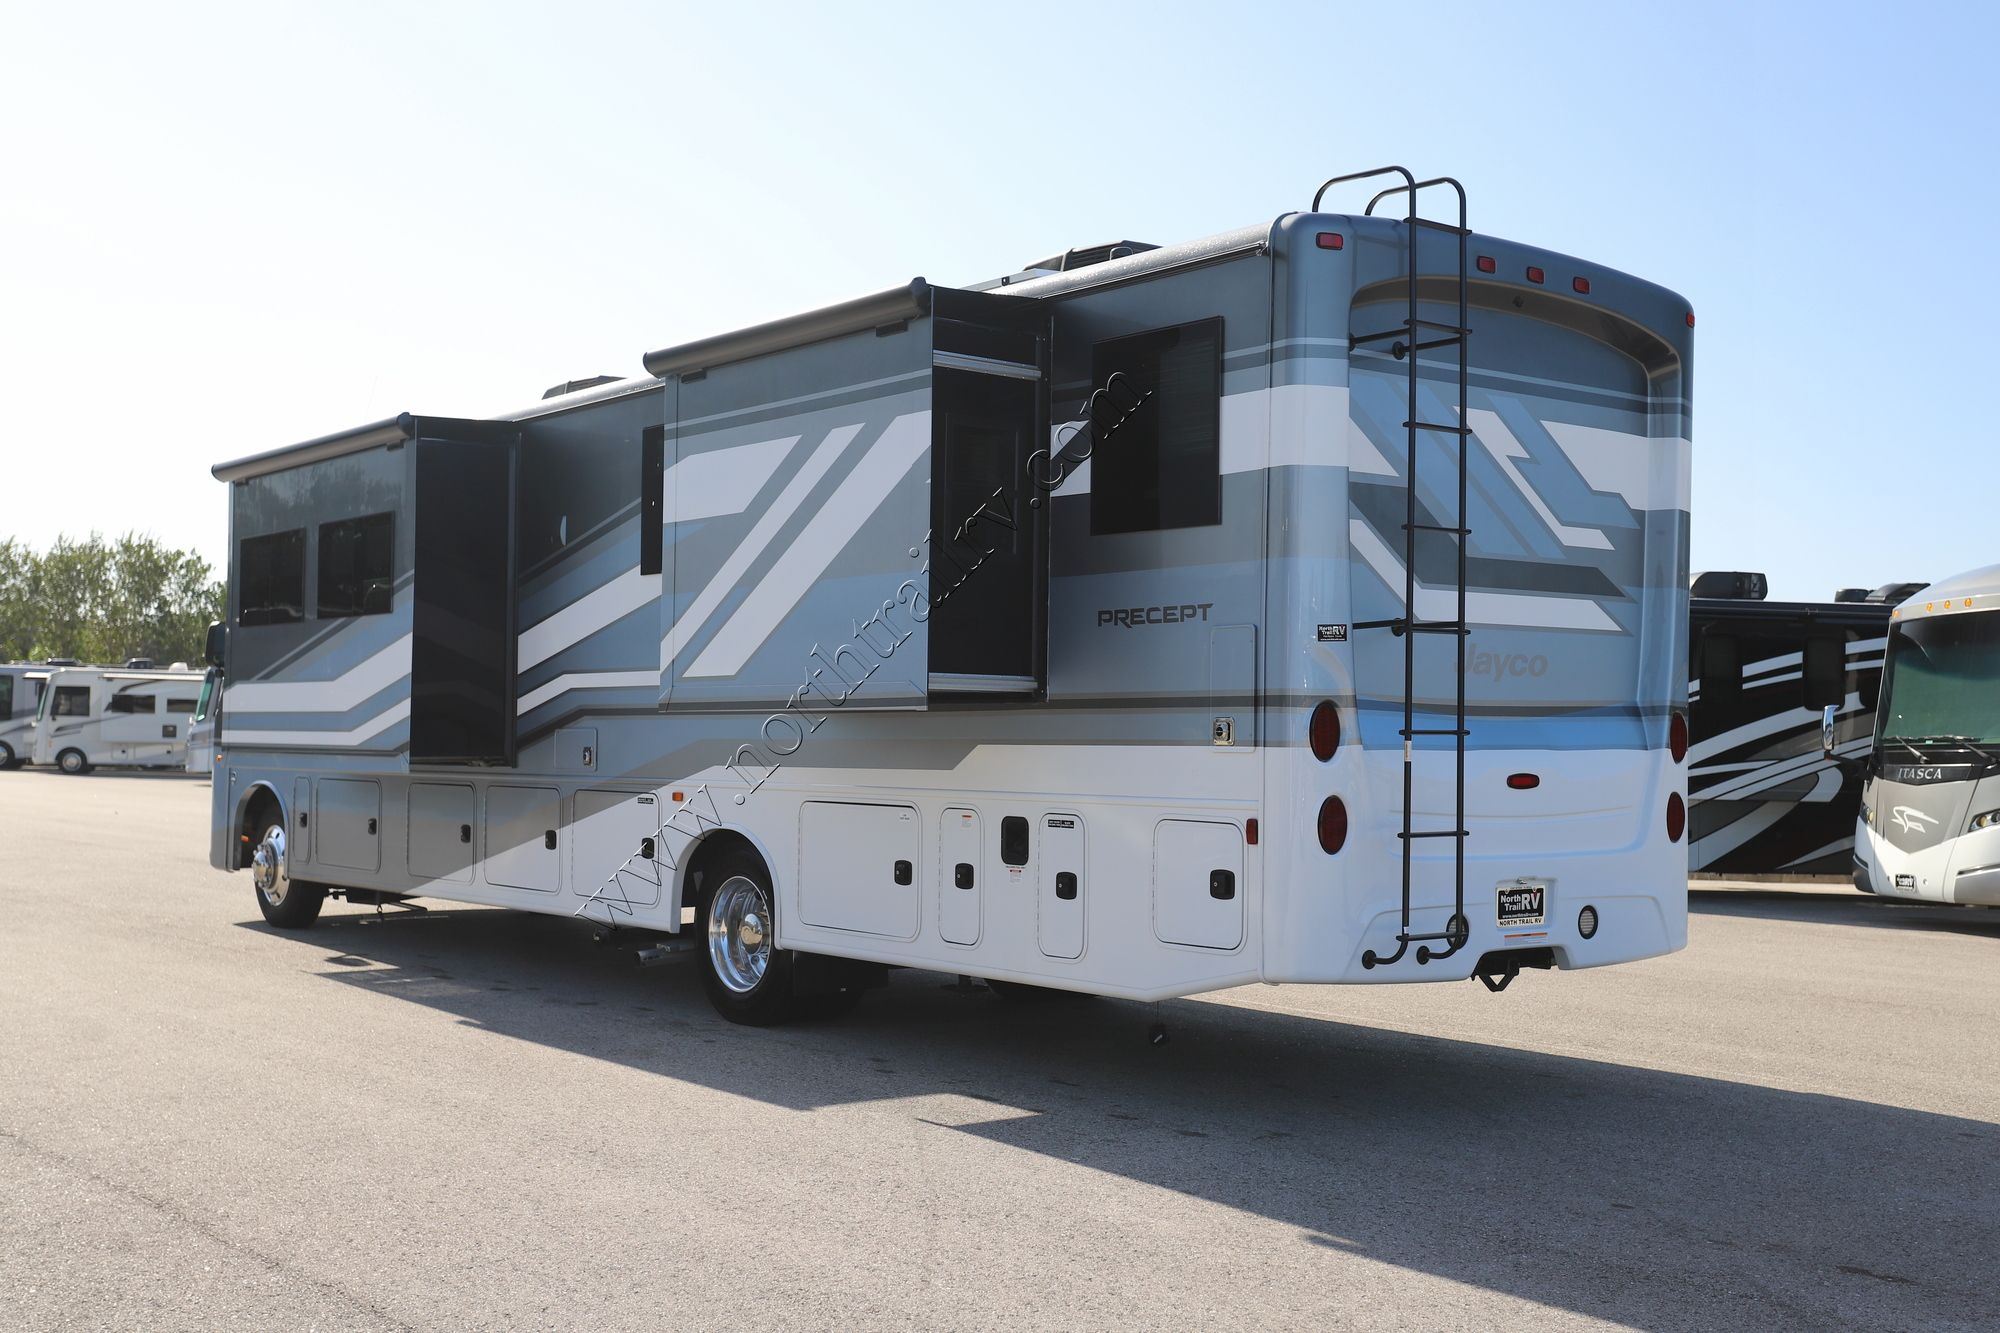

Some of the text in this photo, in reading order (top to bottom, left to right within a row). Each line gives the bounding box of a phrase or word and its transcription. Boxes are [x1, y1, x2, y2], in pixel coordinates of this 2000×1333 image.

[1098, 603, 1214, 629] PRECEPT
[1333, 626, 1345, 635] RV
[1454, 643, 1549, 682] Jayco
[1897, 767, 1942, 780] ITASCA
[1501, 894, 1521, 903] North
[1521, 892, 1541, 910] RV
[1504, 902, 1521, 911] Trail
